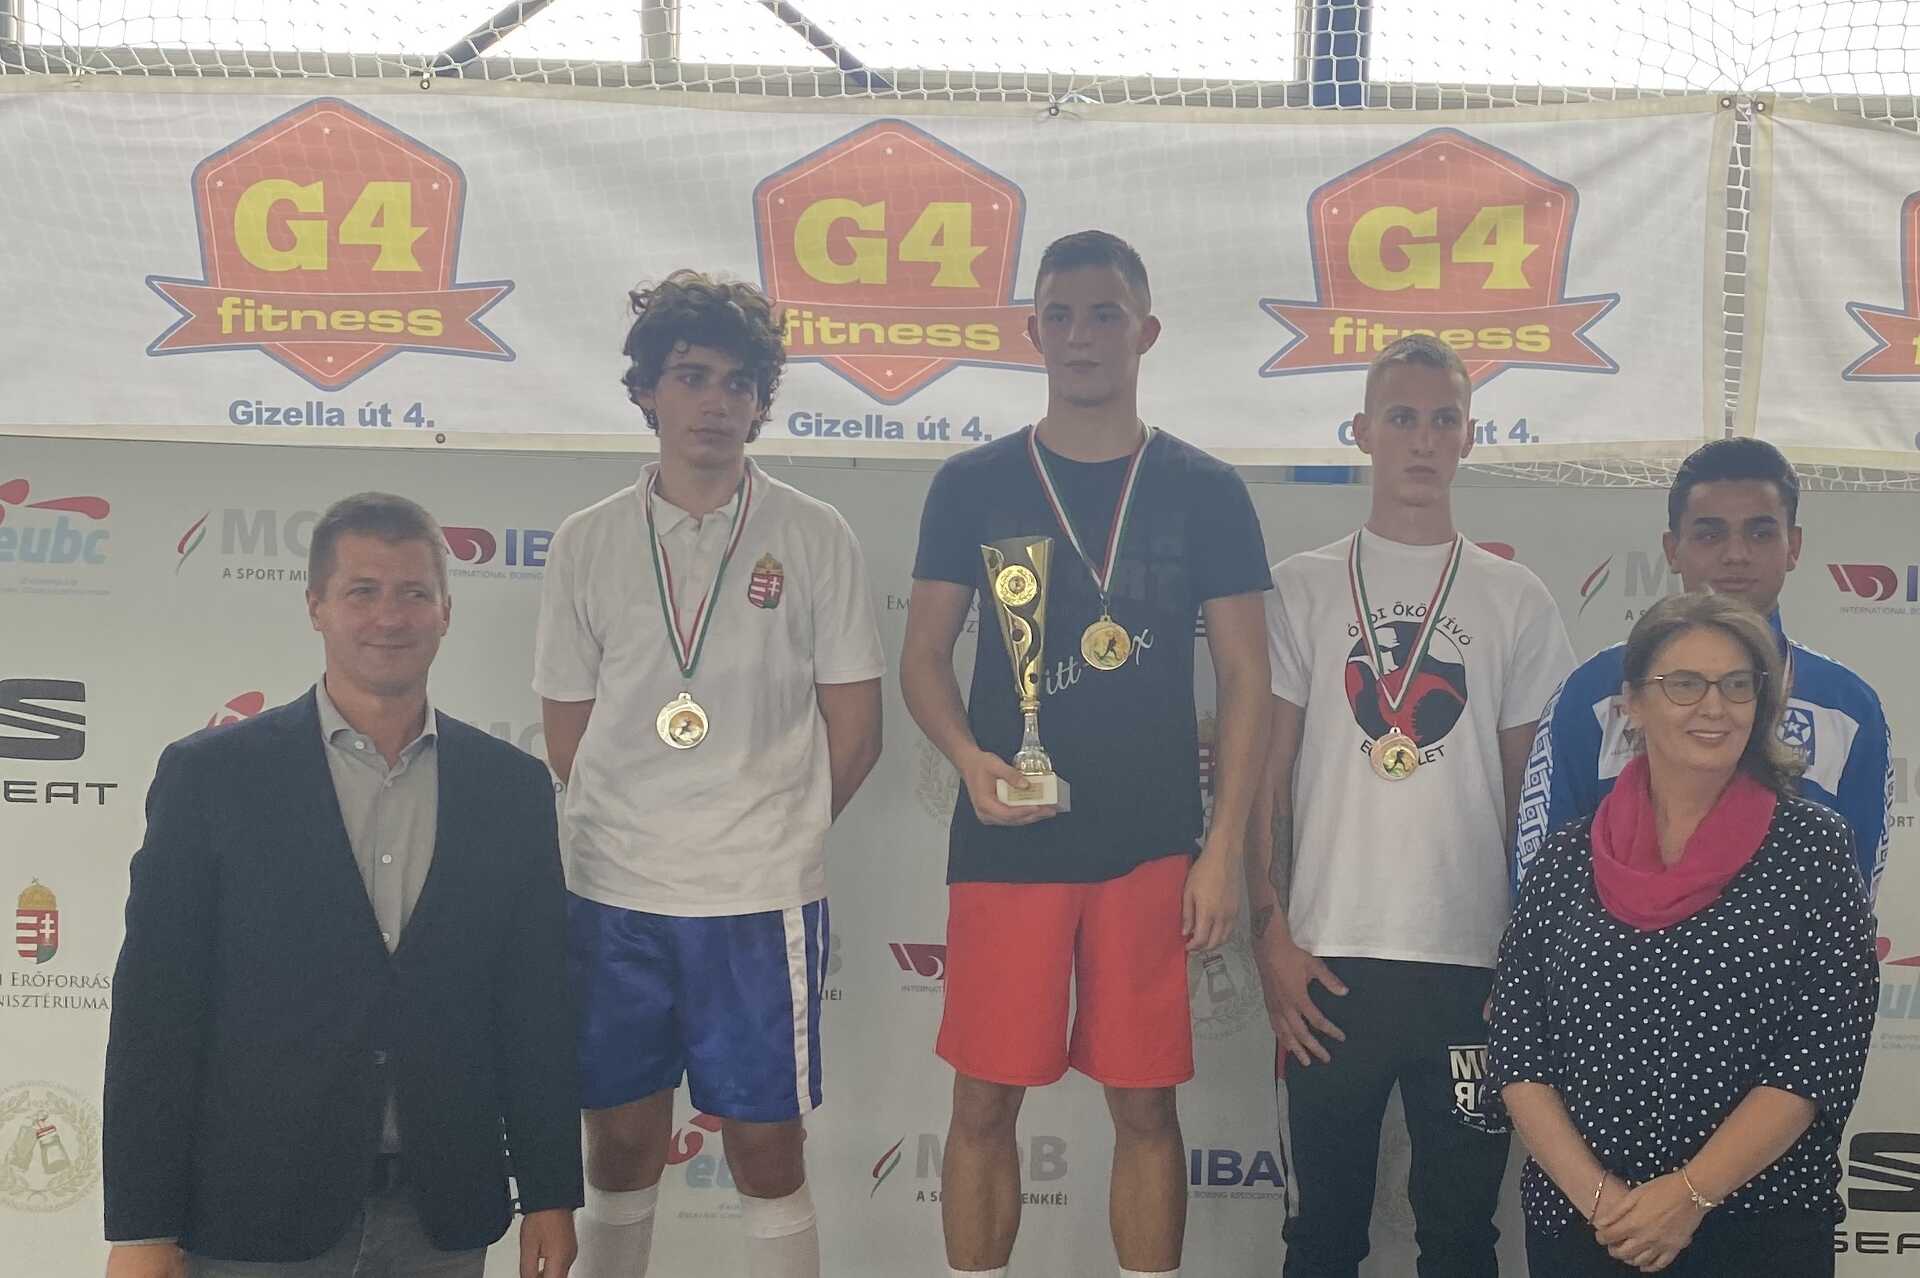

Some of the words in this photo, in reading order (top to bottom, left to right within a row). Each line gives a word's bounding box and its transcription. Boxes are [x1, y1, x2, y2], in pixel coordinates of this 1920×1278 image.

[234, 179, 429, 272] G4
[794, 198, 987, 288] G4
[1347, 205, 1540, 290] G4
[217, 297, 444, 337] fitness
[784, 308, 1000, 351] fitness
[1329, 316, 1551, 353] fitess
[228, 399, 345, 426] Gizella
[358, 401, 391, 427] út
[403, 402, 435, 428] 4.
[787, 411, 904, 440] Gizella
[917, 415, 950, 441] út
[961, 416, 993, 442] 4.
[1508, 418, 1540, 443] 4.
[223, 567, 232, 579] A
[236, 567, 285, 581] SPORT
[3, 780, 118, 805] EAT
[0, 992, 110, 1010] ISZTÉRIUMA
[1190, 1149, 1285, 1187] IBA
